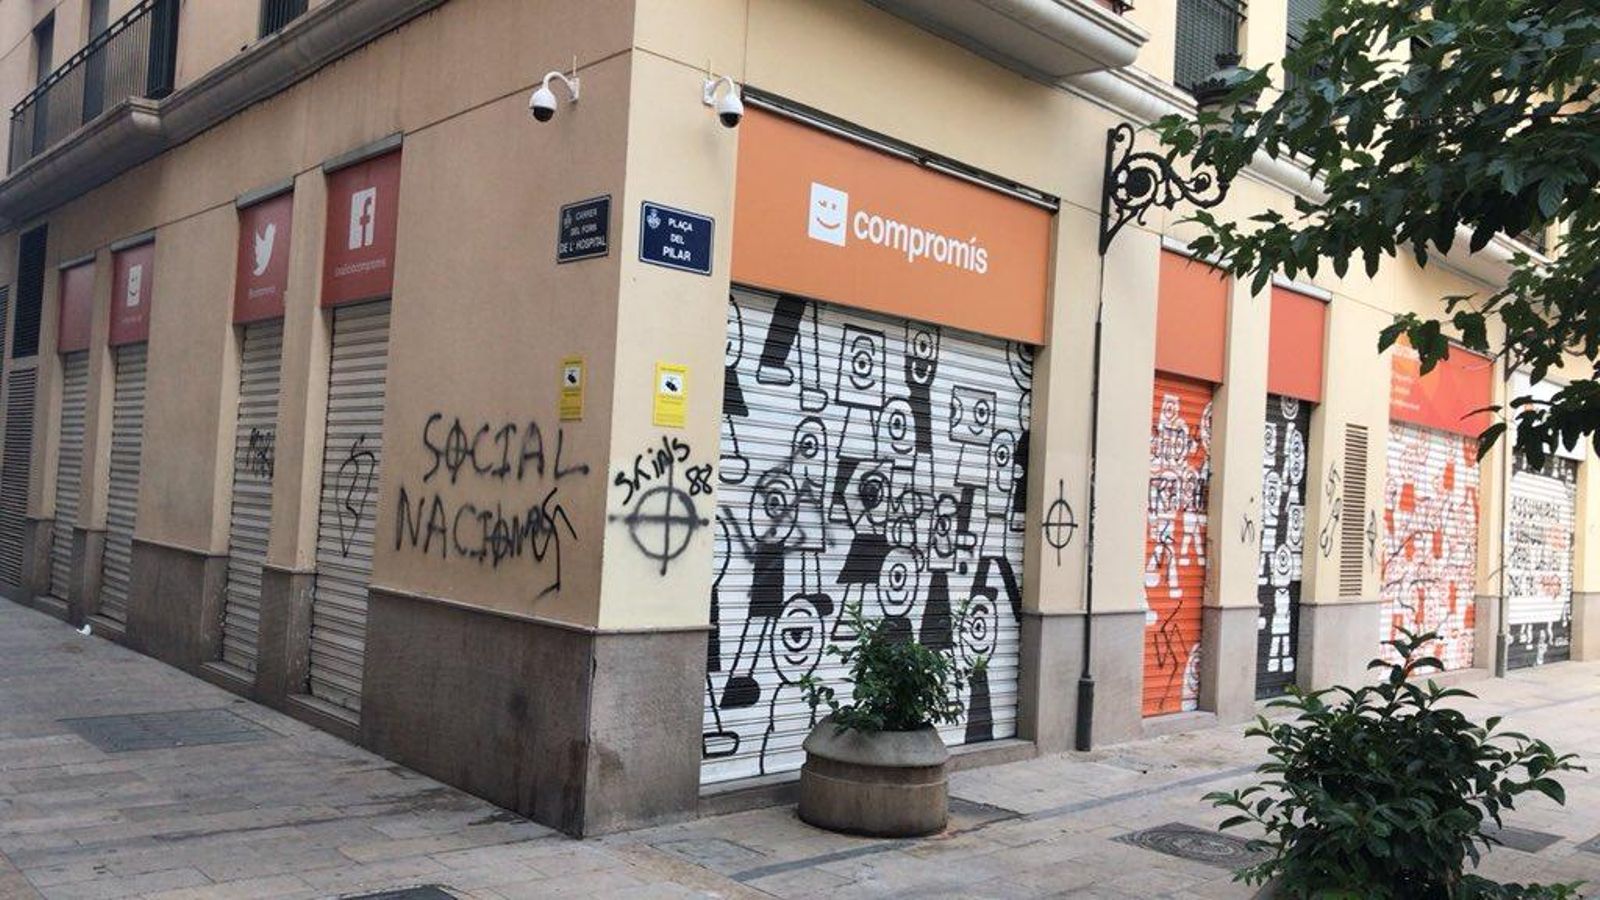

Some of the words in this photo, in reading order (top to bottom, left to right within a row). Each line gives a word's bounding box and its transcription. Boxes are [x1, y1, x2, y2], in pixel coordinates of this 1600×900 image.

[667, 217, 694, 233] PLAÇA
[559, 242, 568, 254] DE
[576, 235, 606, 250] HOSPITAL
[669, 232, 685, 245] DEL
[853, 210, 988, 274] compromís
[662, 246, 692, 261] PILAR
[423, 412, 590, 485] SOCIAL
[685, 463, 713, 496] 88
